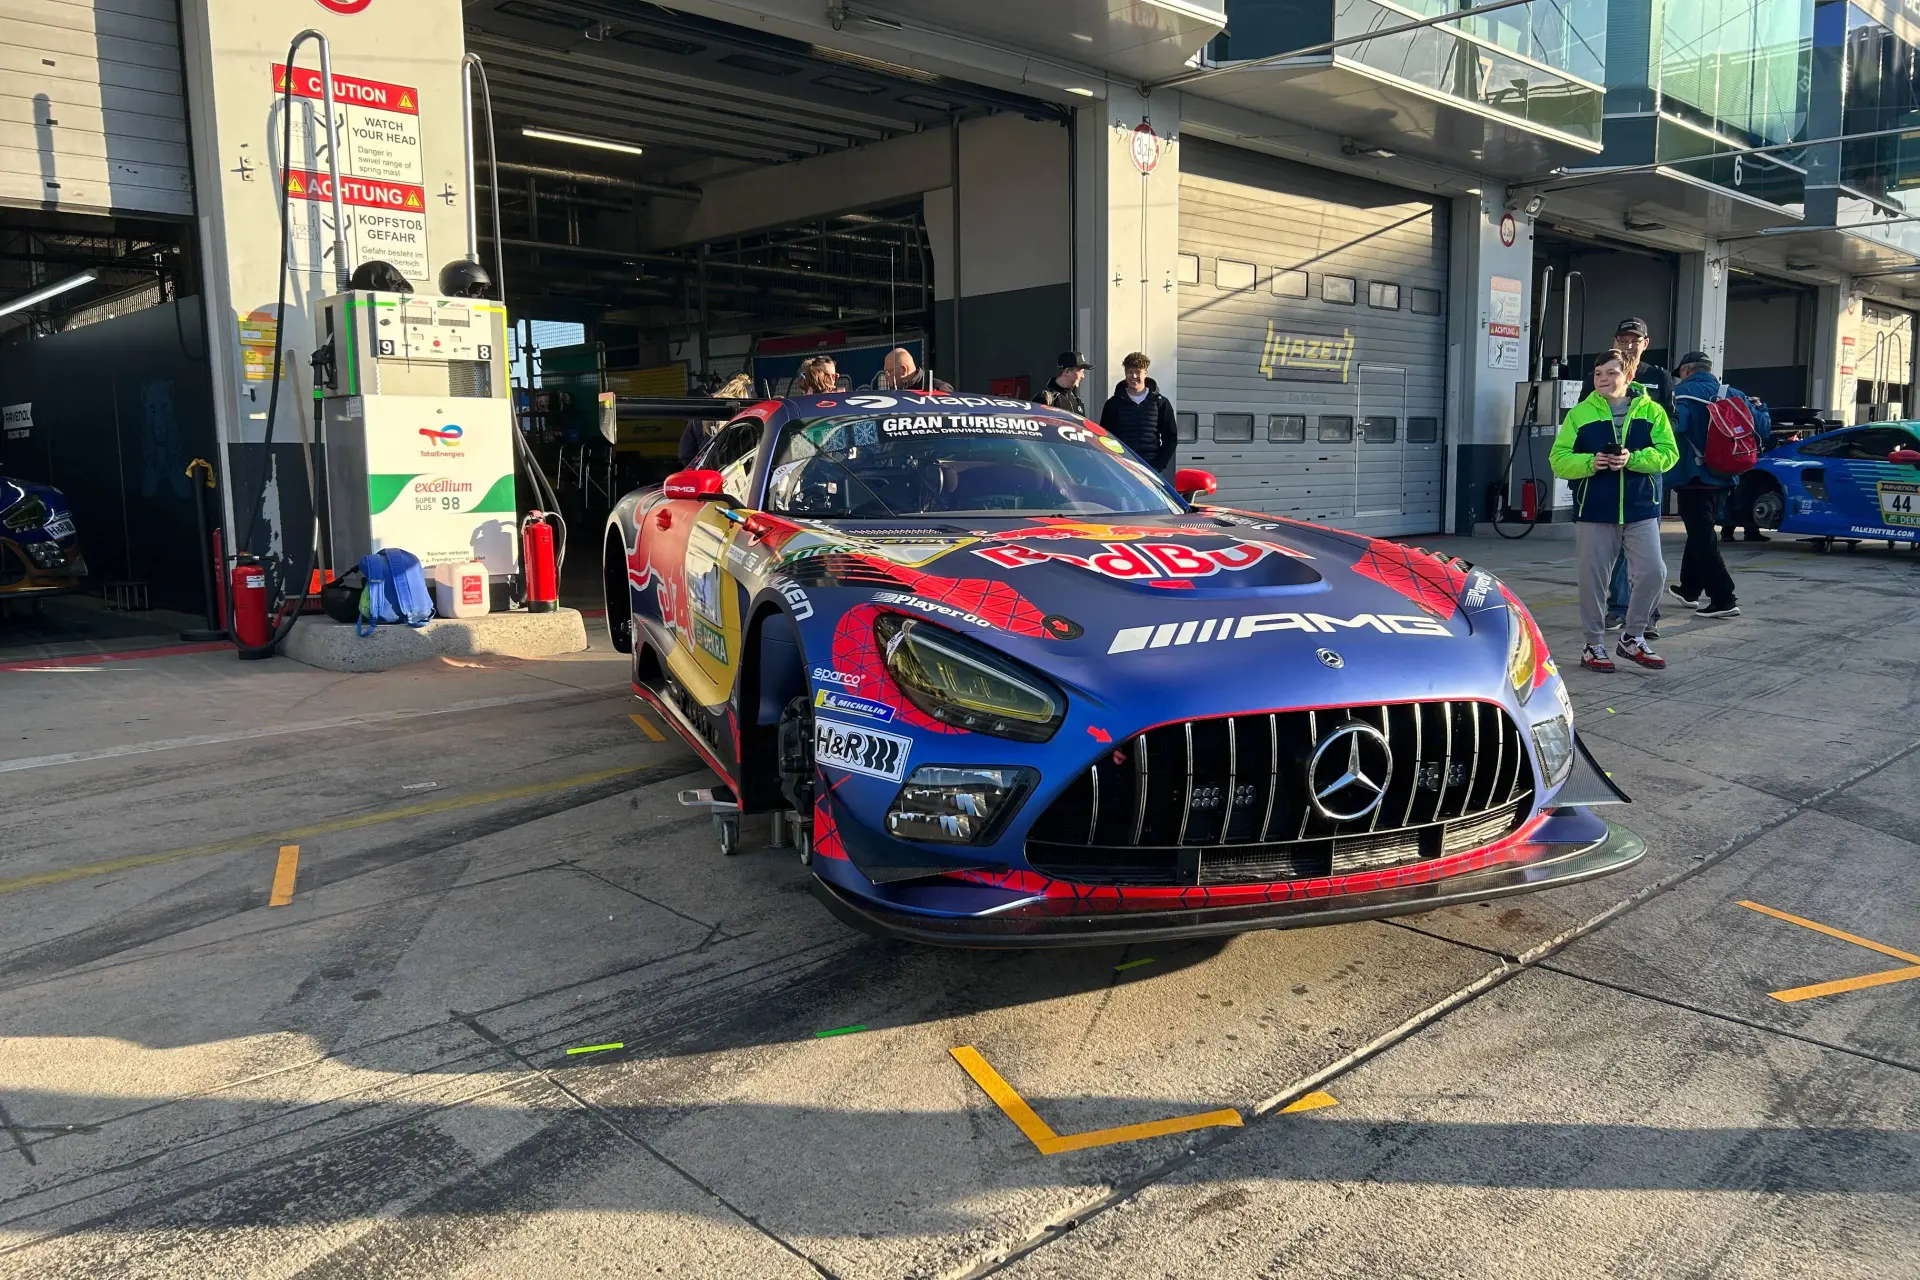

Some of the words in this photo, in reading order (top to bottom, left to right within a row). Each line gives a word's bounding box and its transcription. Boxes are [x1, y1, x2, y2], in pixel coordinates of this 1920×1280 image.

[308, 77, 387, 104] CUTION
[364, 116, 404, 132] WATCH
[352, 127, 384, 141] YOUR
[386, 132, 417, 146] HEAD
[357, 146, 385, 157] Danger
[386, 150, 393, 158] in
[358, 156, 381, 165] swivel
[382, 160, 403, 169] range
[404, 161, 412, 169] of
[1734, 155, 1743, 186] 6
[359, 165, 380, 175] spring
[382, 168, 401, 177] mast
[307, 178, 403, 205] ACHTUNG
[367, 229, 416, 243] GEFAHR
[361, 245, 387, 256] Gefahr
[388, 246, 414, 258] besteht
[414, 249, 424, 259] im
[381, 341, 392, 355] 9
[479, 346, 490, 359] 8
[1271, 335, 1346, 366] HAZET
[902, 395, 1032, 411] viaplay
[883, 416, 943, 433] GRAN
[985, 428, 1043, 437] SIMULATOR
[420, 450, 465, 459] TotalEnergies
[414, 479, 473, 493] excellium
[415, 496, 437, 504] SUPER
[441, 496, 461, 511] 98
[1892, 494, 1912, 513] 44
[1851, 526, 1915, 538] FALKENTYRE.COM
[768, 575, 814, 622] LKEN
[893, 594, 964, 618] Player
[962, 613, 991, 628] 0.0
[1233, 613, 1454, 638] AMG
[813, 667, 862, 686] sparco
[837, 699, 888, 716] MICHELIN
[815, 725, 864, 762] H&R
